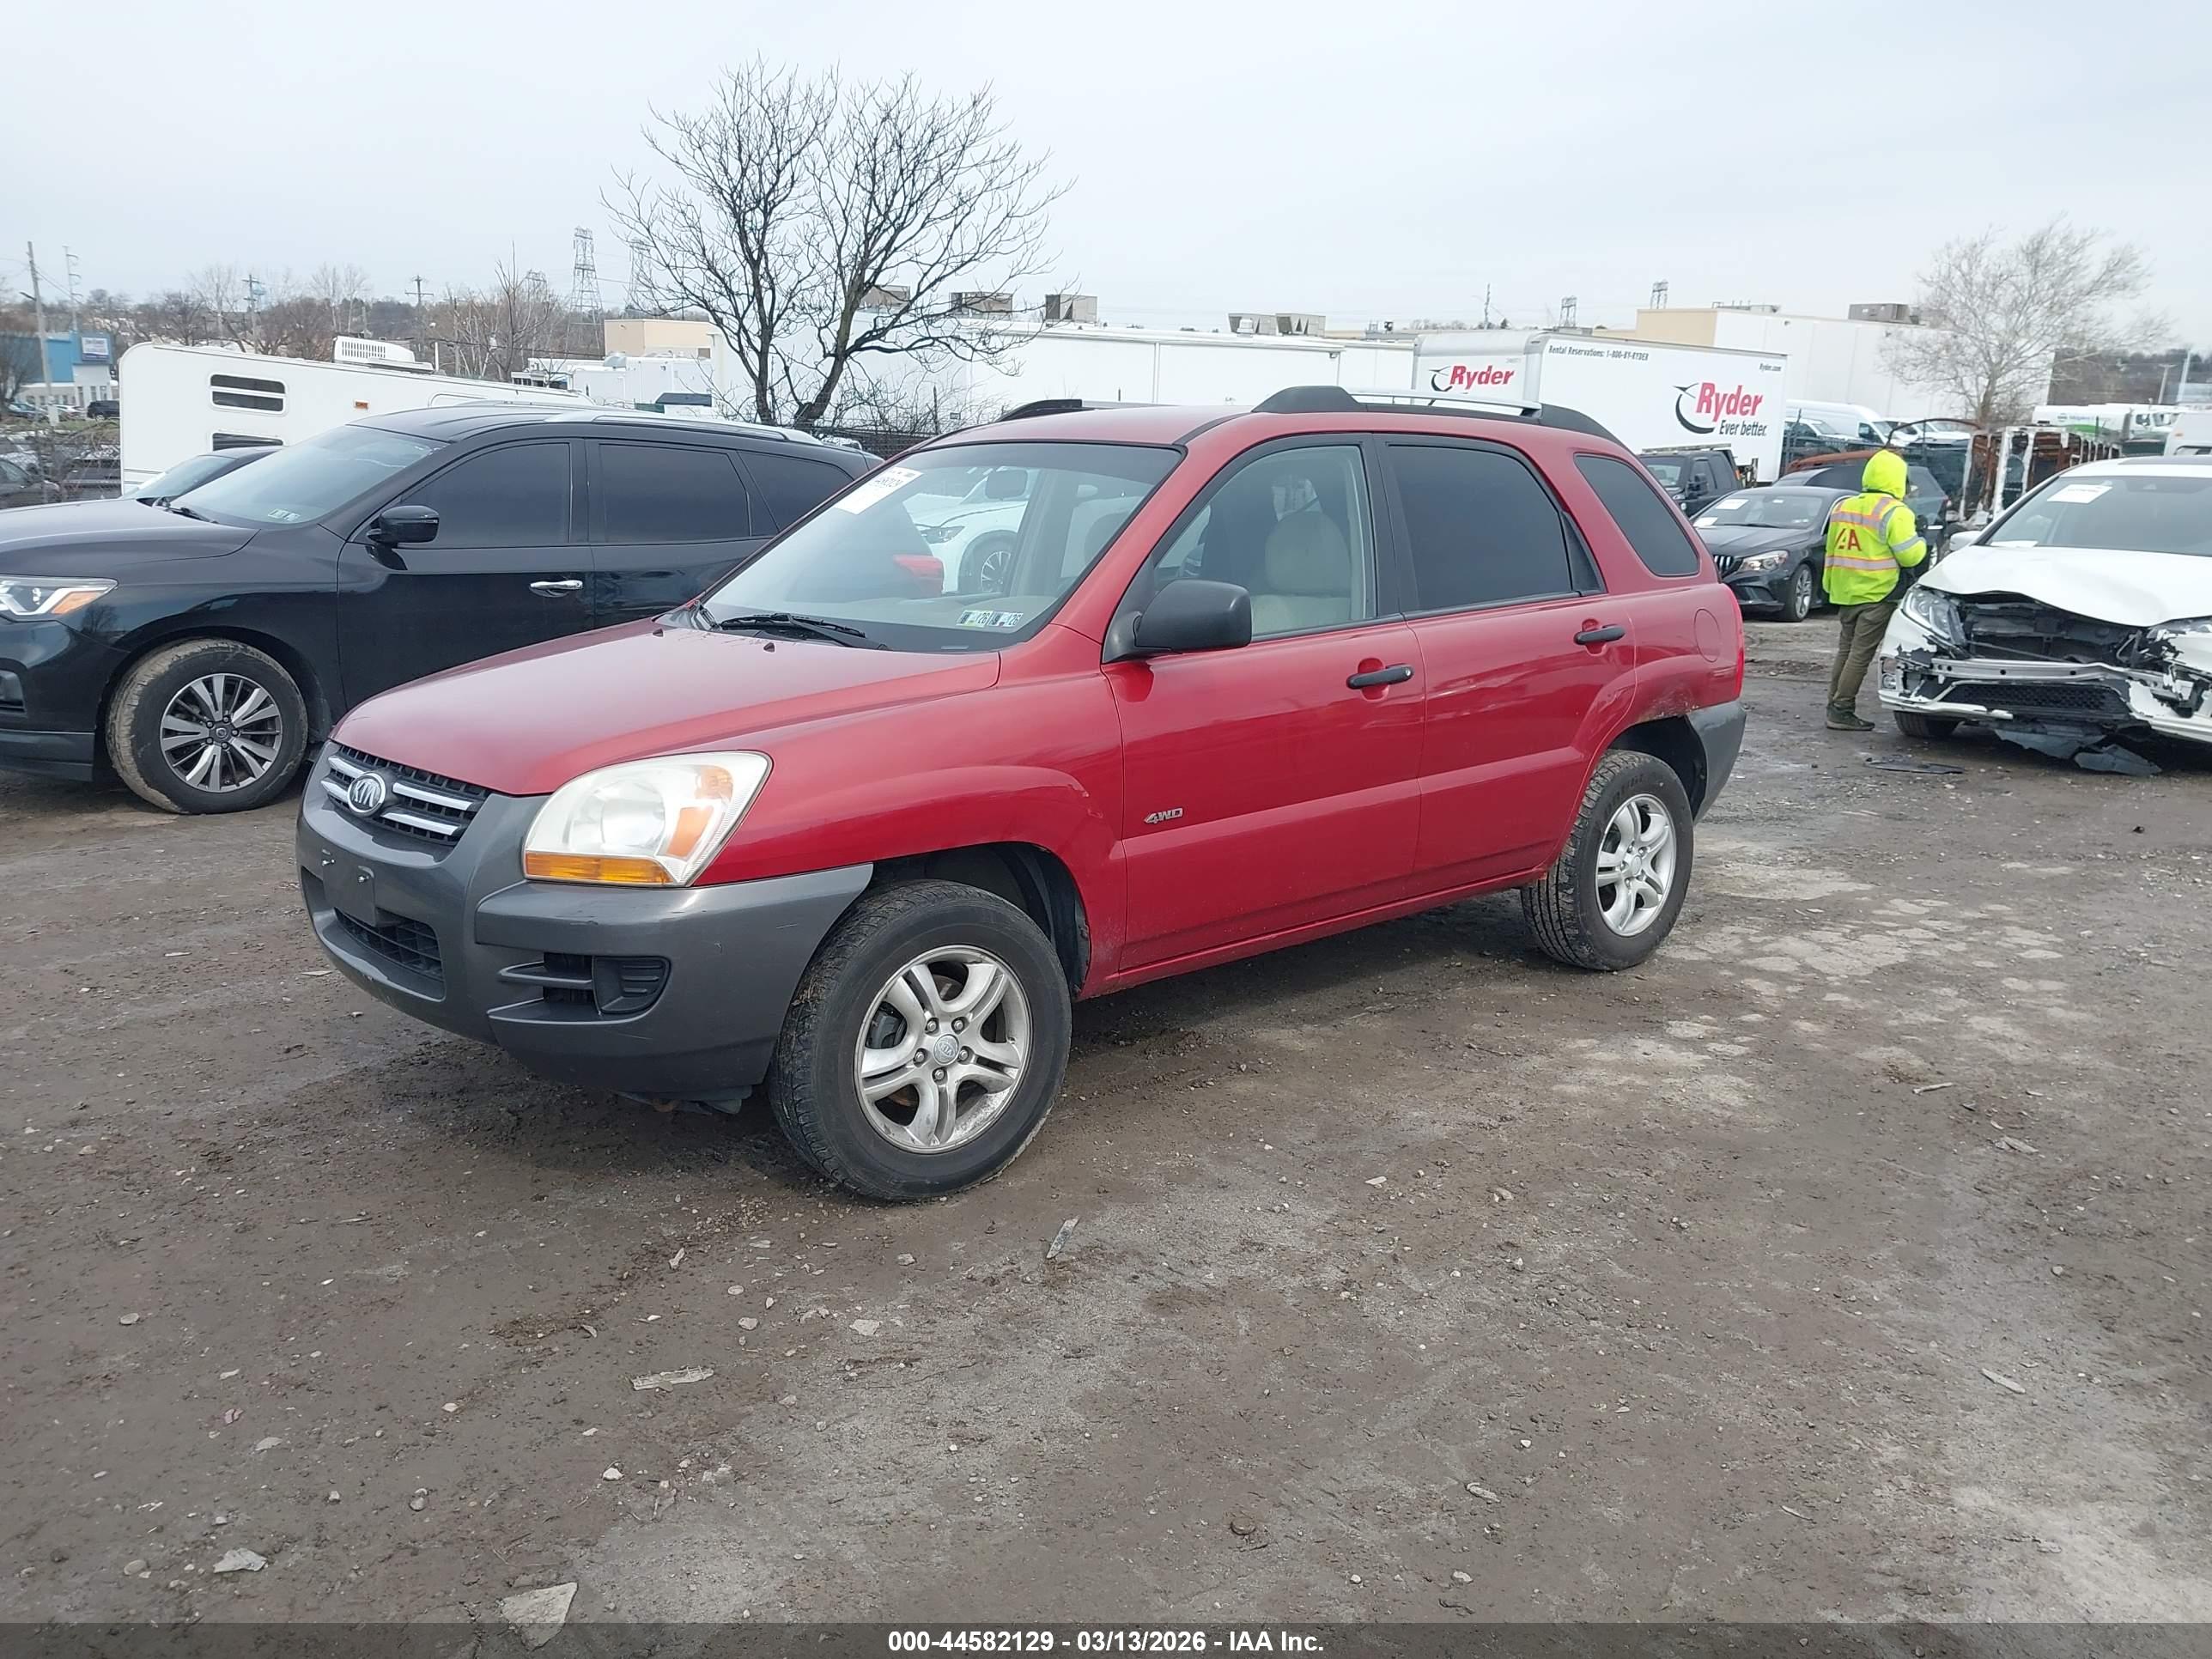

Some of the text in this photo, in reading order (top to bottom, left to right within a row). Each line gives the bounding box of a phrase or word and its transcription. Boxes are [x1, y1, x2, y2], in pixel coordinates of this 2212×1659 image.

[1548, 345, 1567, 355] Rental
[1449, 365, 1515, 390] Ryder
[1696, 381, 1763, 422] Ryder
[1719, 420, 1739, 435] Ever
[1143, 807, 1183, 824] 4WD
